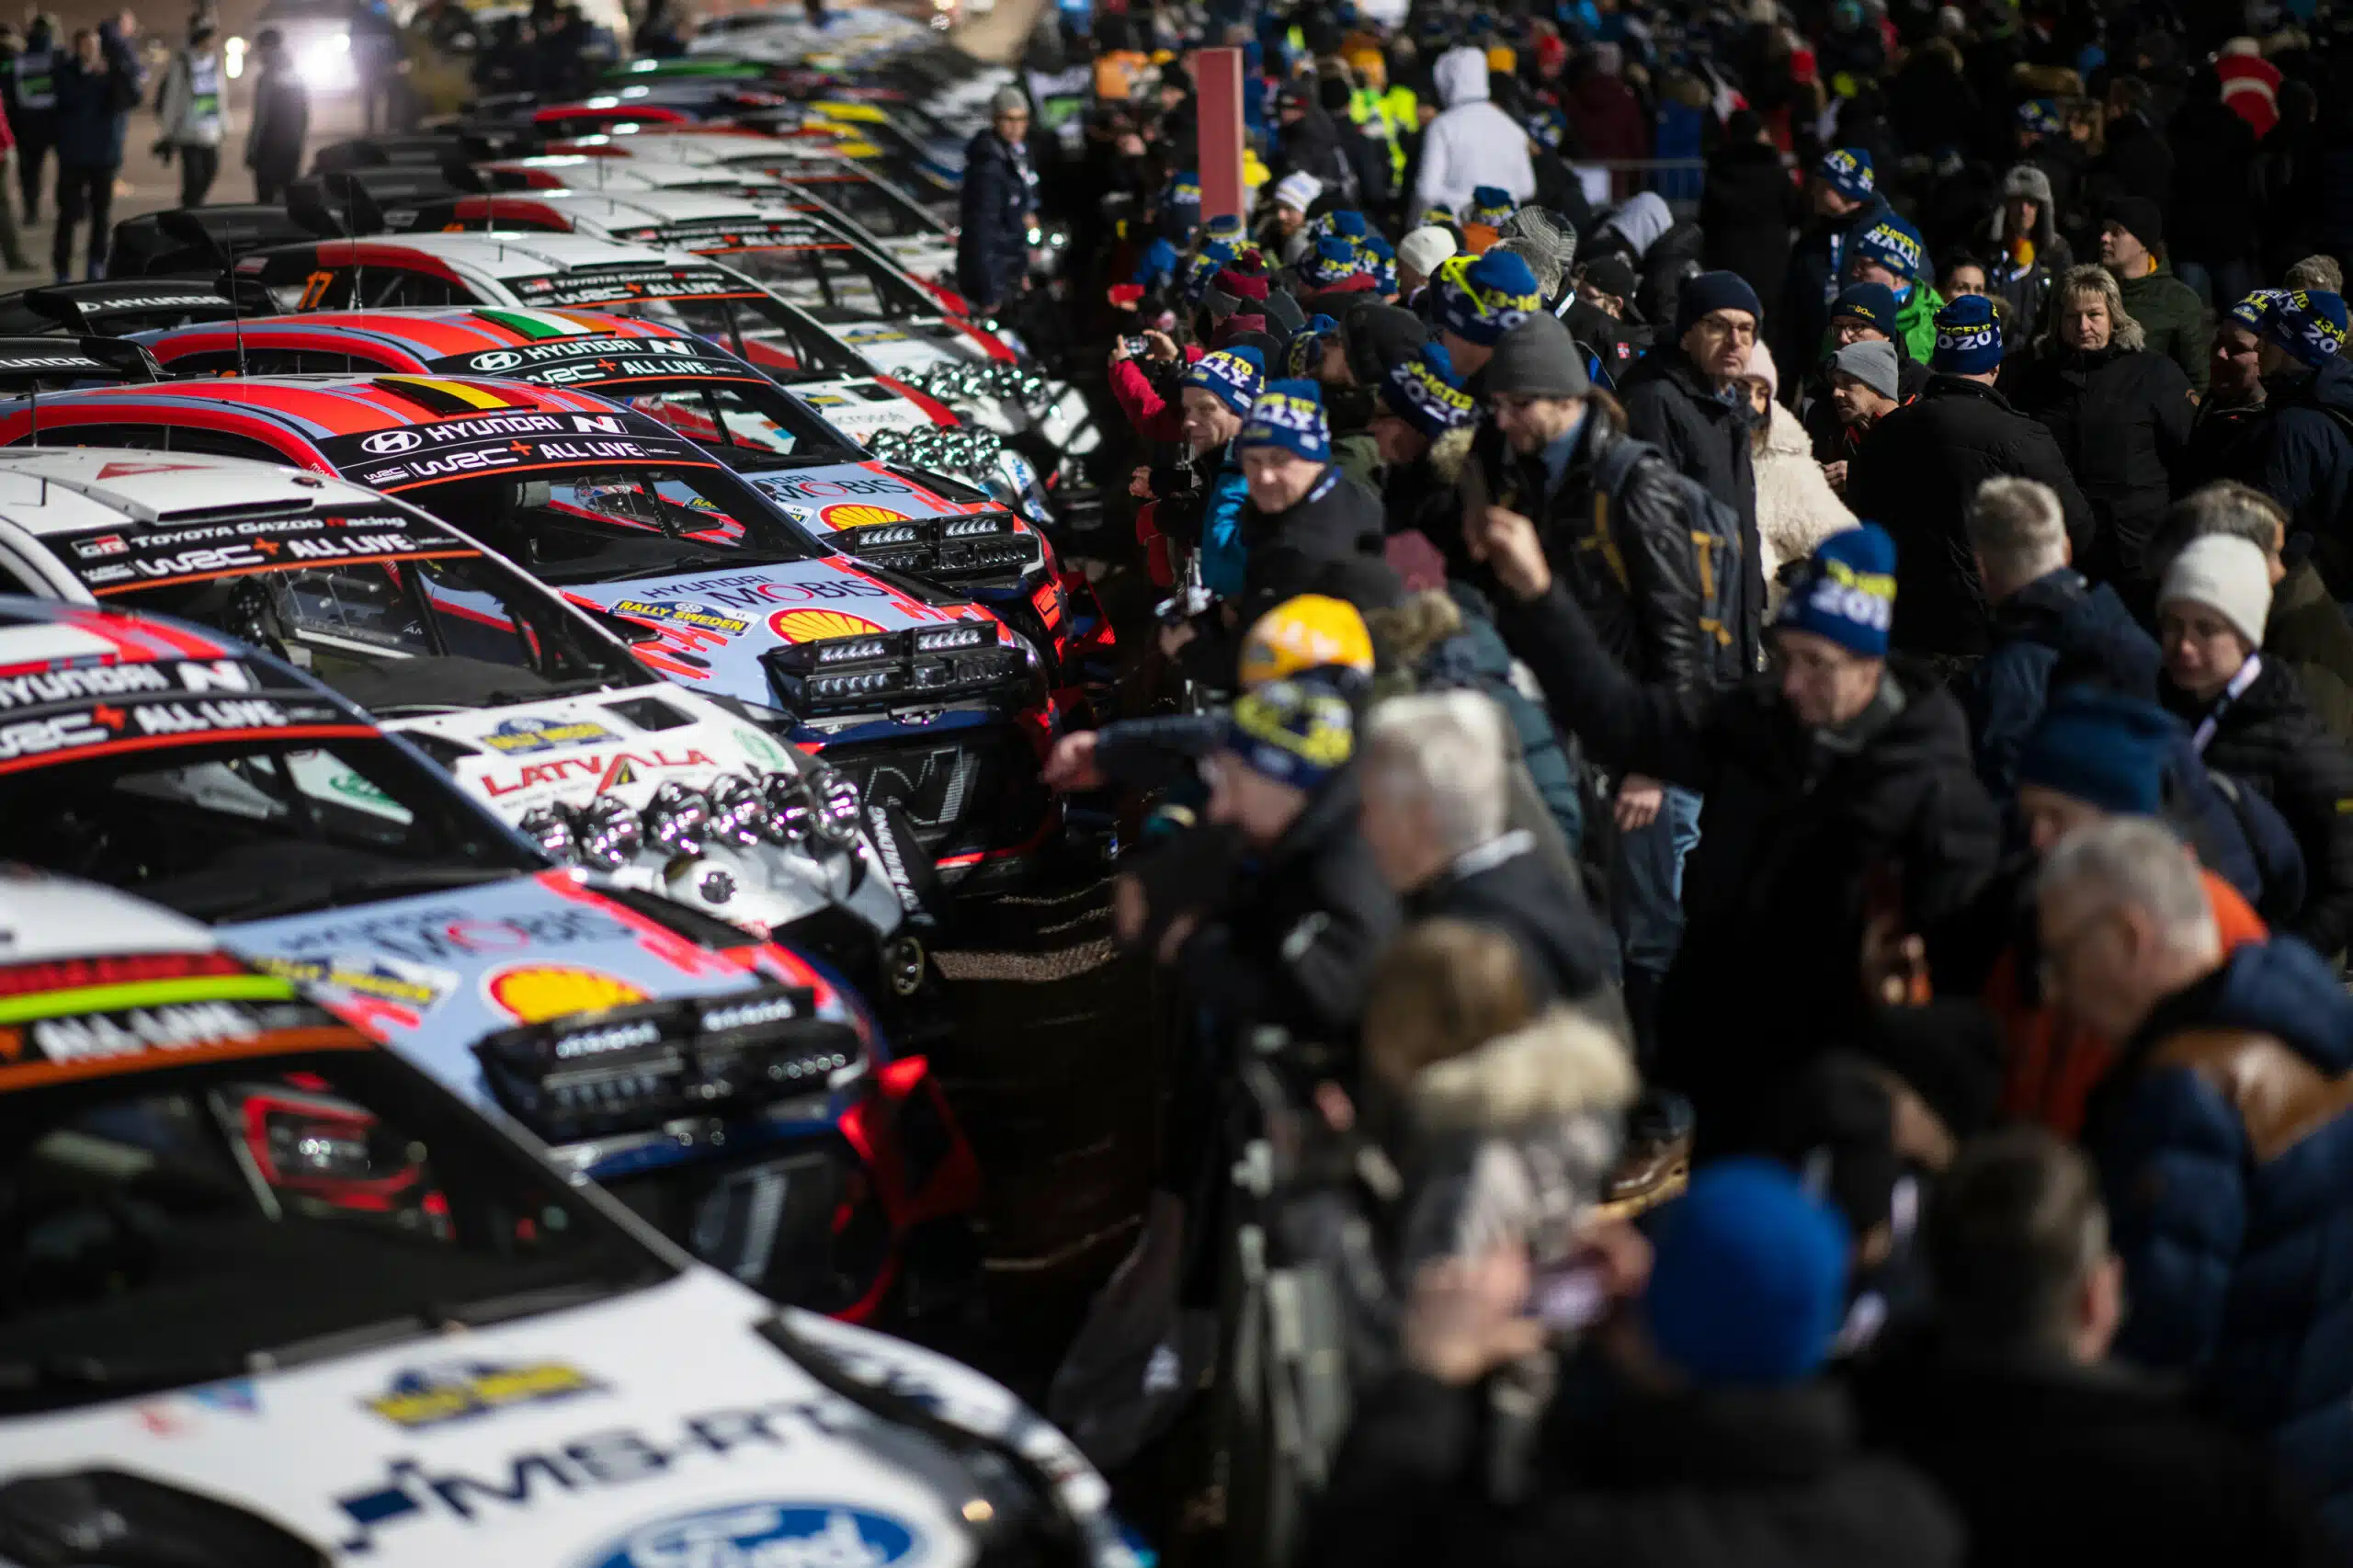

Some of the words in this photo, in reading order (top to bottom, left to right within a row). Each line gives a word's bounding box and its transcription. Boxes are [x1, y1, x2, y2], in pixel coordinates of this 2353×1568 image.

[295, 270, 334, 310] 17
[524, 339, 642, 360] HYUNDAI
[1937, 330, 1992, 351] 020
[621, 360, 665, 375] ALL
[661, 359, 712, 375] LIVE
[425, 415, 563, 441] HYUNDAI
[539, 442, 591, 460] ALL
[587, 441, 645, 457] LIVE
[776, 479, 913, 502] MOBIS
[130, 526, 235, 549] TOYOTA
[236, 518, 324, 535] GAZOO
[325, 517, 408, 528] Racing
[287, 537, 350, 558] ALL
[342, 533, 416, 552] LIVE
[641, 574, 775, 598] HYUNDAI
[705, 580, 890, 609] MOBIS
[618, 600, 673, 617] RALLY
[672, 610, 747, 632] SWEDEN
[134, 702, 210, 735] ALL
[199, 699, 289, 730] LIVE
[480, 749, 717, 796] LATVALA
